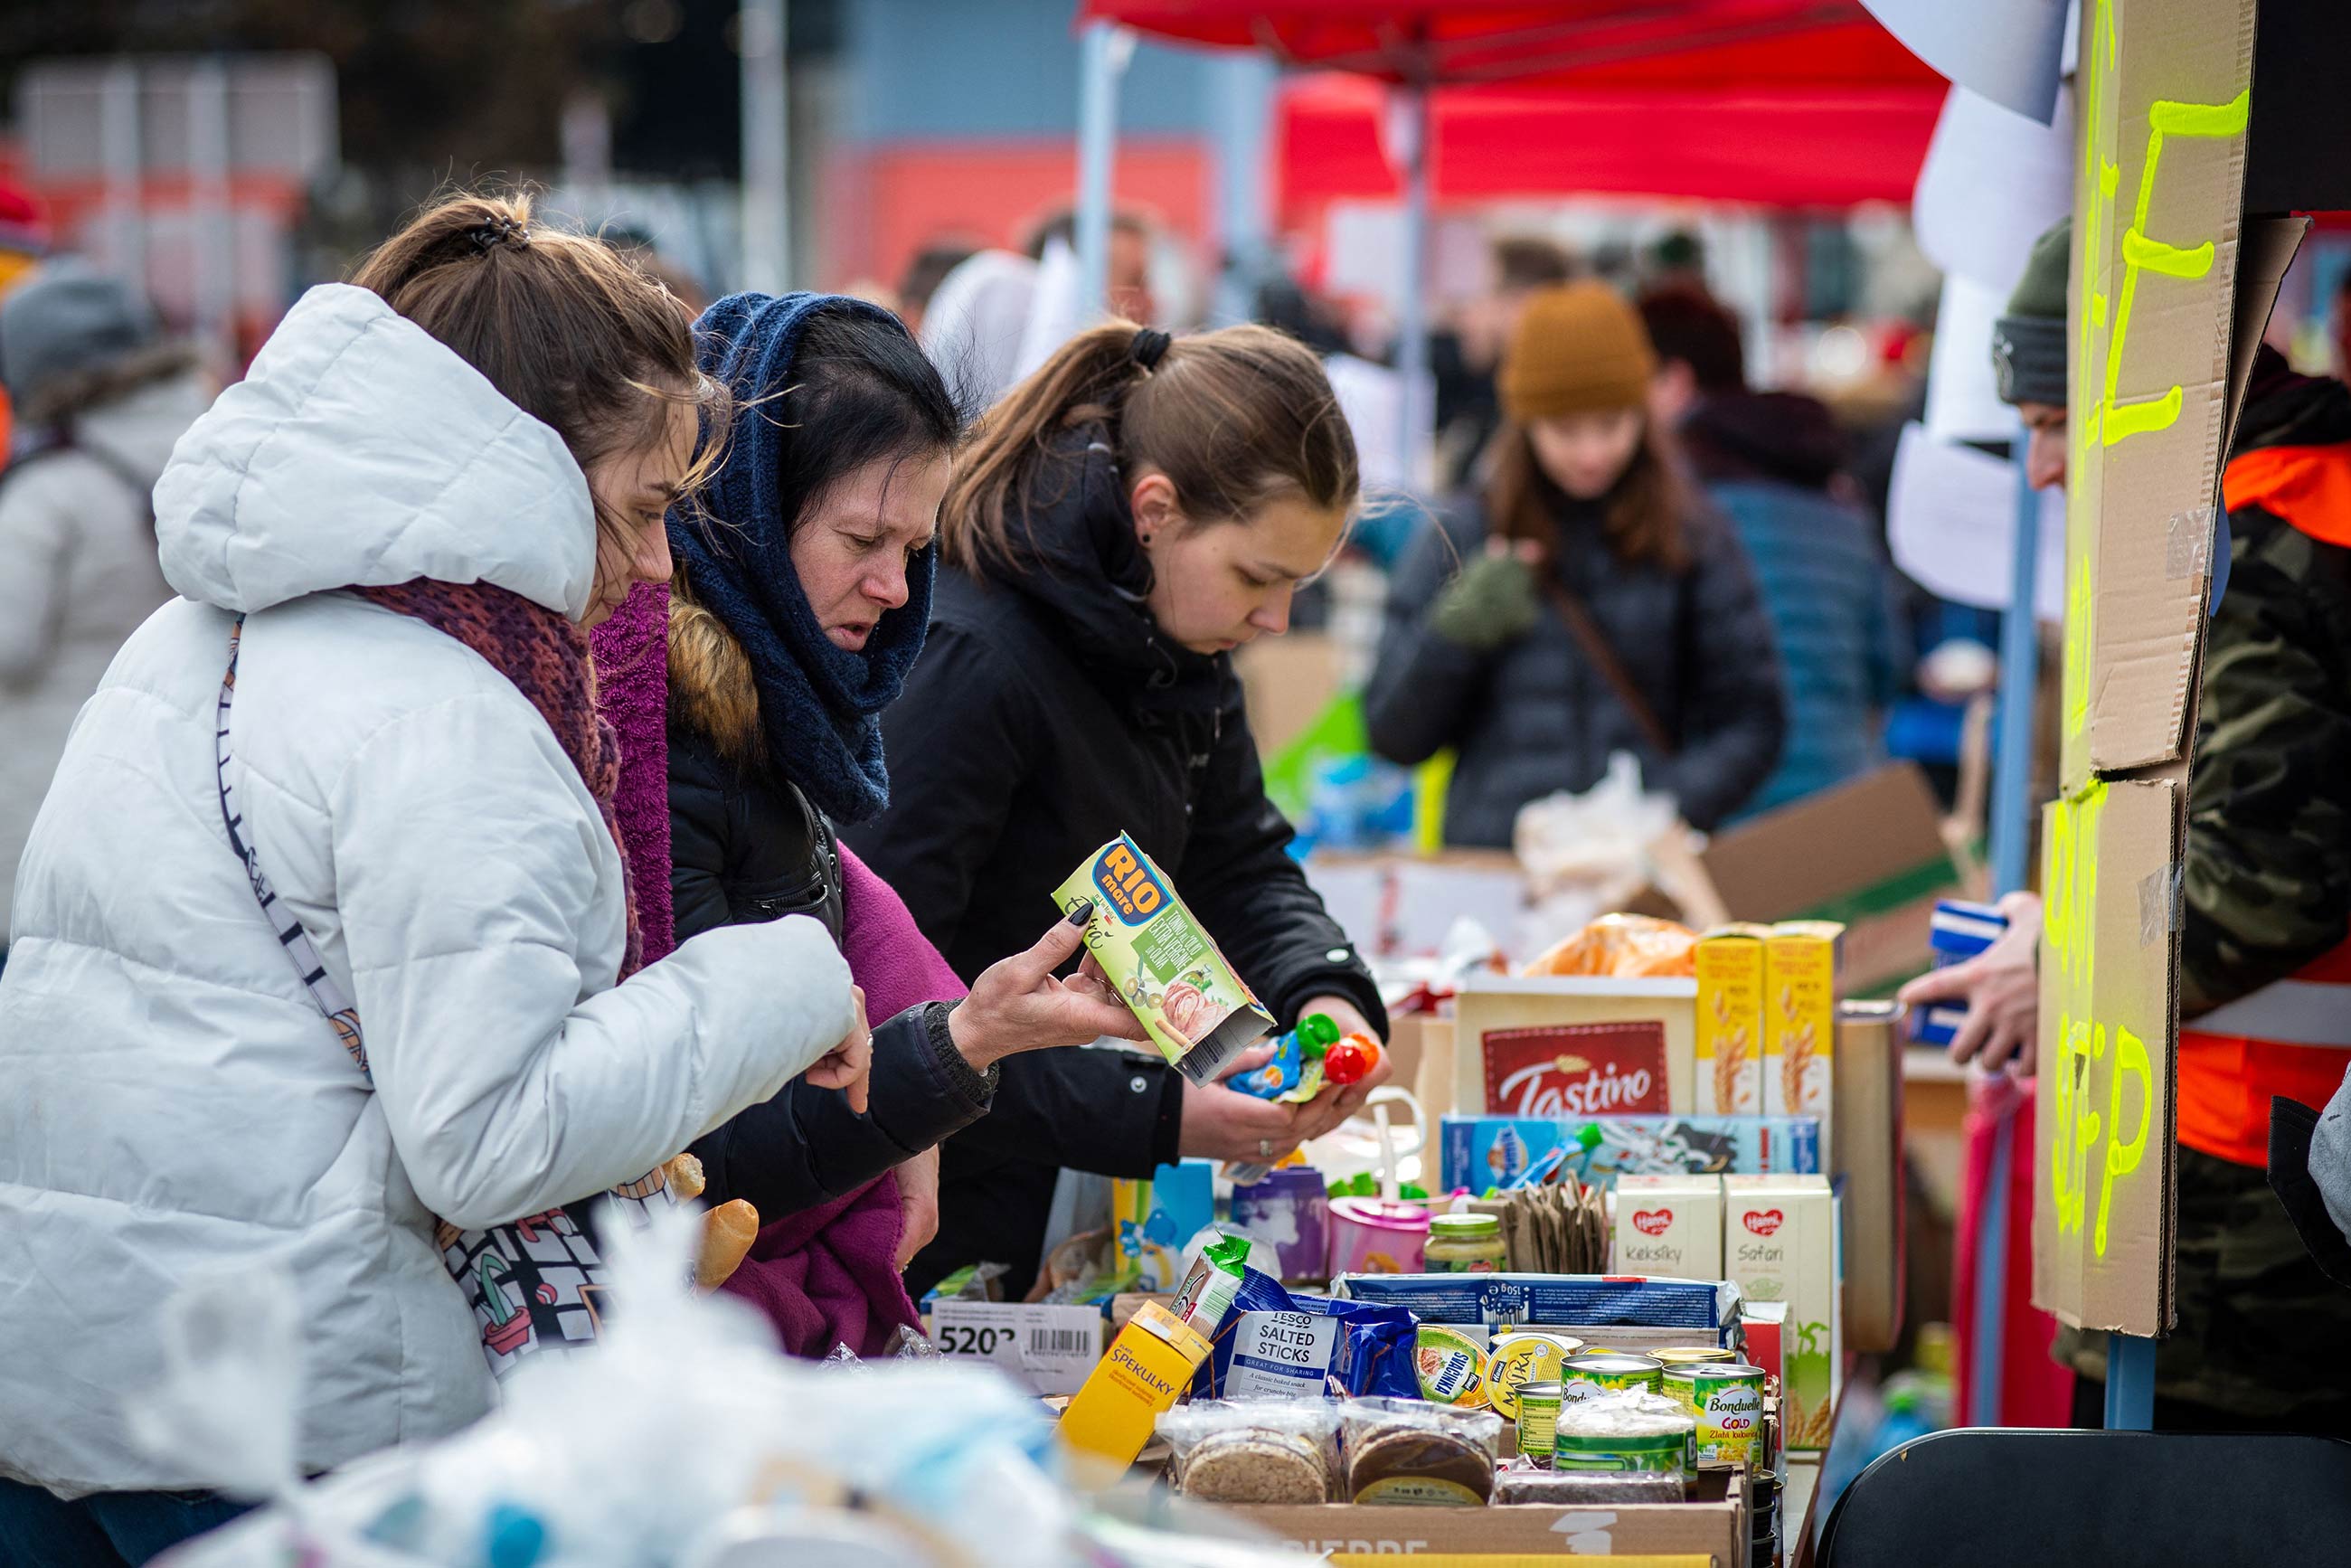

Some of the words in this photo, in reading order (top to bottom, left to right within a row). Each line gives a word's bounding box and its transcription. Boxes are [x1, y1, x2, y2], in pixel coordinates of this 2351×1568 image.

[1104, 844, 1161, 914] RIO
[1101, 874, 1134, 915] mare
[1166, 910, 1187, 936] TONNO
[1148, 918, 1175, 947] EXTRA
[1163, 937, 1193, 972] VERGINE
[1149, 947, 1169, 970] OLIVA
[1499, 1062, 1651, 1116] Tastino
[1738, 1243, 1784, 1262] Safari
[1273, 1311, 1312, 1326] TESCO
[1260, 1325, 1315, 1346] SALTED
[1258, 1342, 1310, 1363] STICKS
[1109, 1348, 1175, 1396] SPEKULKY
[1245, 1358, 1268, 1369] GREAT
[1270, 1364, 1284, 1373] FOR
[1285, 1366, 1314, 1376] SHARING
[1435, 1351, 1469, 1395] SVAČINKA
[1254, 1374, 1273, 1383] classic
[1274, 1376, 1291, 1385] baked
[1290, 1380, 1306, 1388] snack
[1263, 1387, 1286, 1397] crunchy
[1709, 1397, 1761, 1415] Bonduelle
[1722, 1417, 1750, 1430] GOLD
[1709, 1430, 1730, 1439] Zlatá
